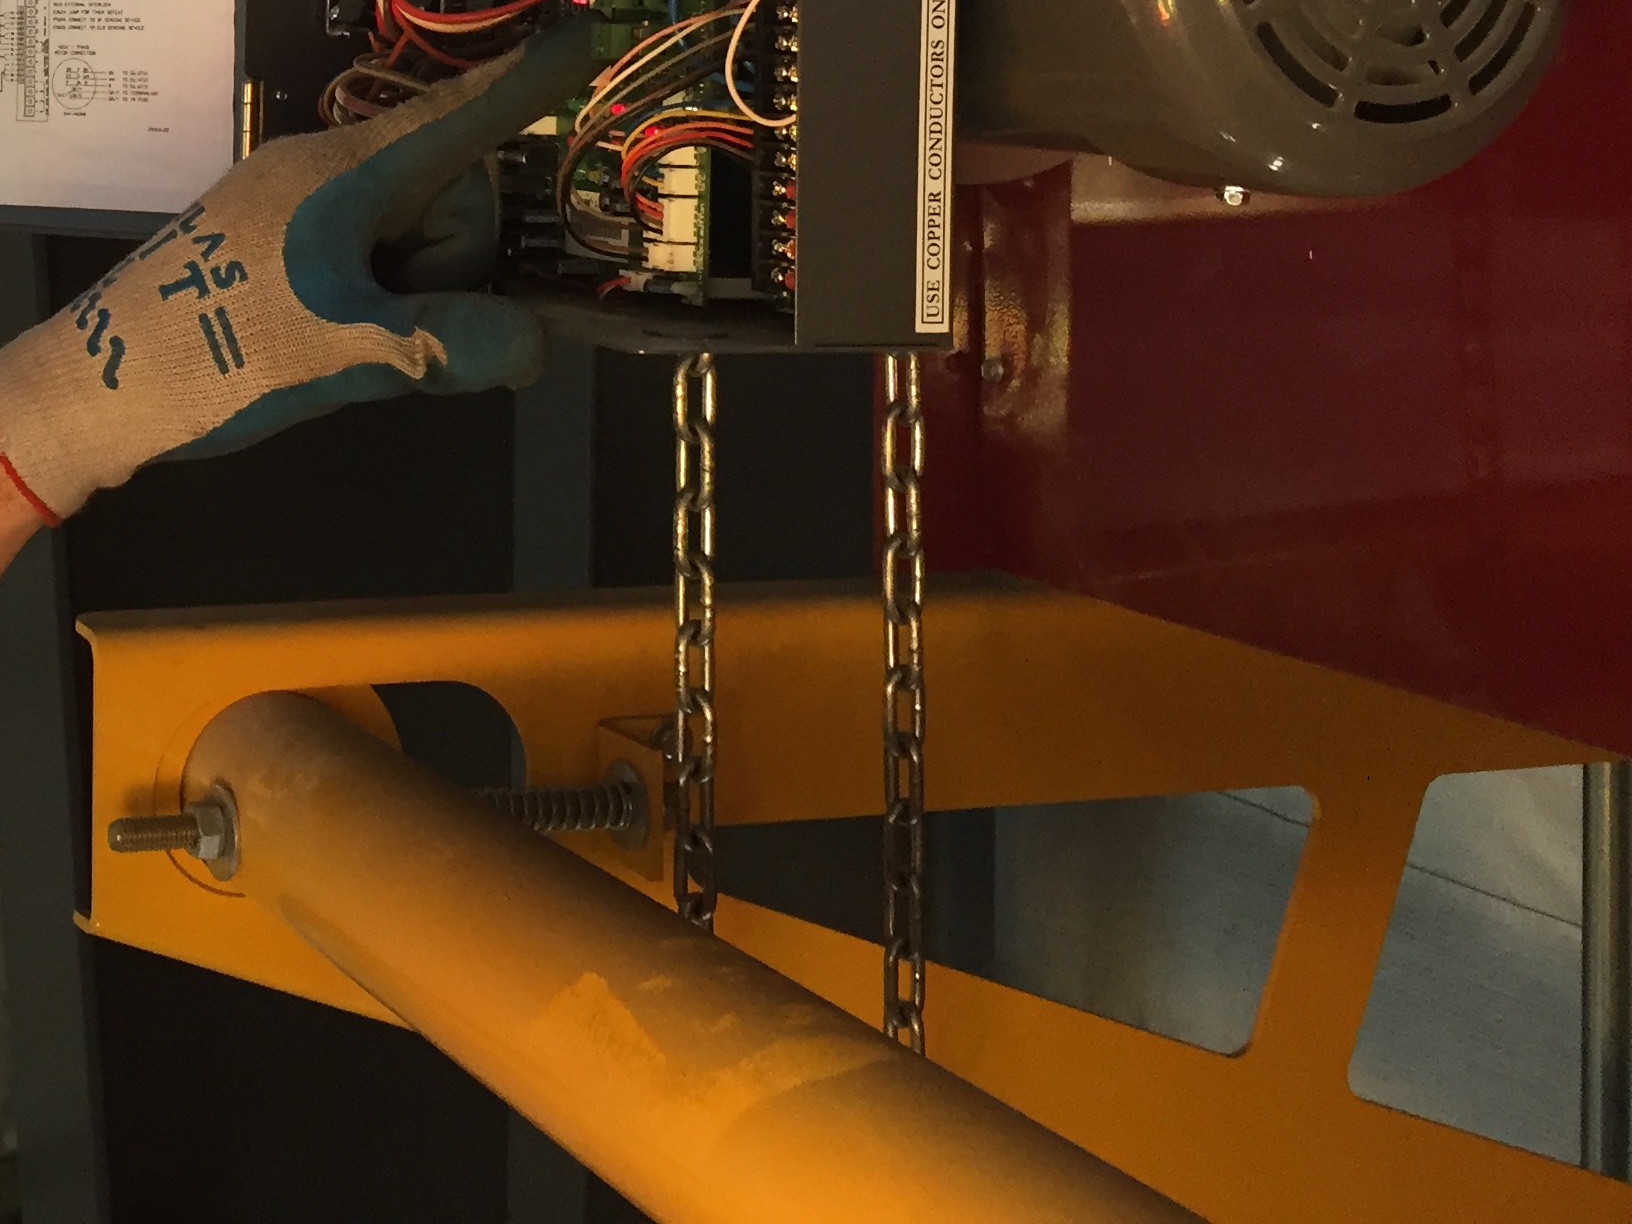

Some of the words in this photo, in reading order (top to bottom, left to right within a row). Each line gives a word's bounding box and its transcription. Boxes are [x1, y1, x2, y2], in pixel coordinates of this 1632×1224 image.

[928, 39, 945, 181] CONDUCTORS
[179, 201, 248, 290] LAS
[927, 191, 941, 270] COPPER
[926, 280, 940, 318] USE
